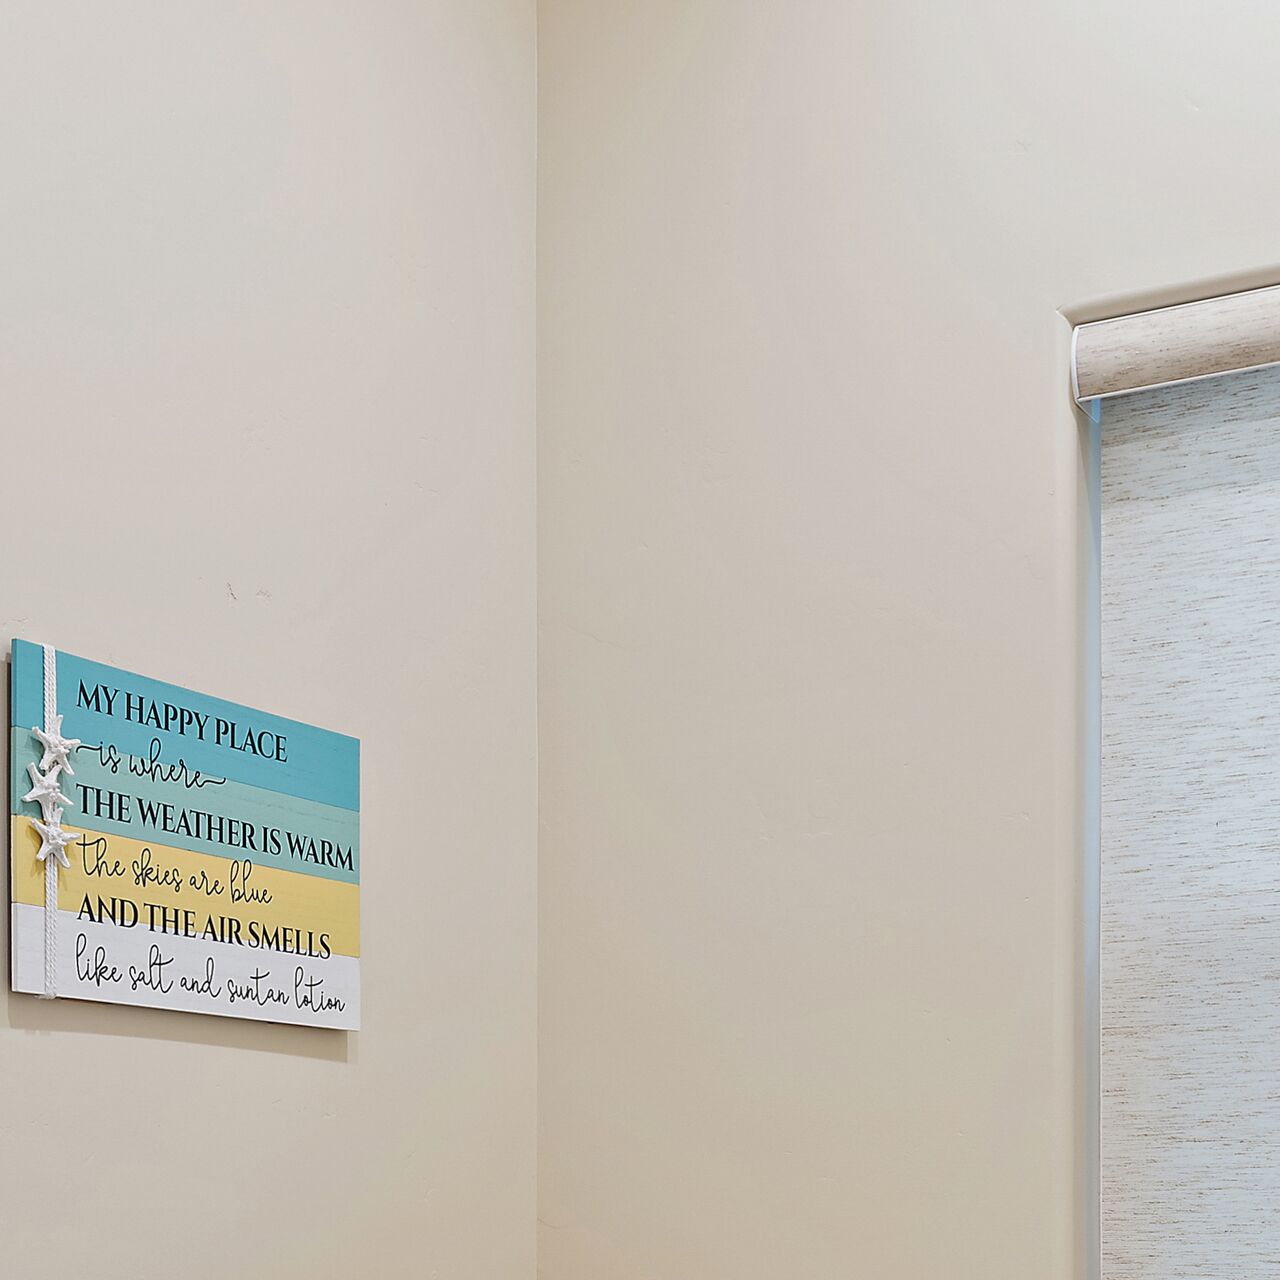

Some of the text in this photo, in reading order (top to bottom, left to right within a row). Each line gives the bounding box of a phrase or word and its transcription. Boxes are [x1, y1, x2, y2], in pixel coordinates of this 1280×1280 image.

[76, 679, 289, 763] MY HAPPY PLACE
[75, 738, 227, 789] is where
[75, 784, 355, 871] THE WEATHER IS WARM
[76, 833, 273, 905] the skies are blue
[76, 893, 331, 960] AND THE AIR SMELLS
[76, 932, 346, 1014] like salt and suntan lotion
